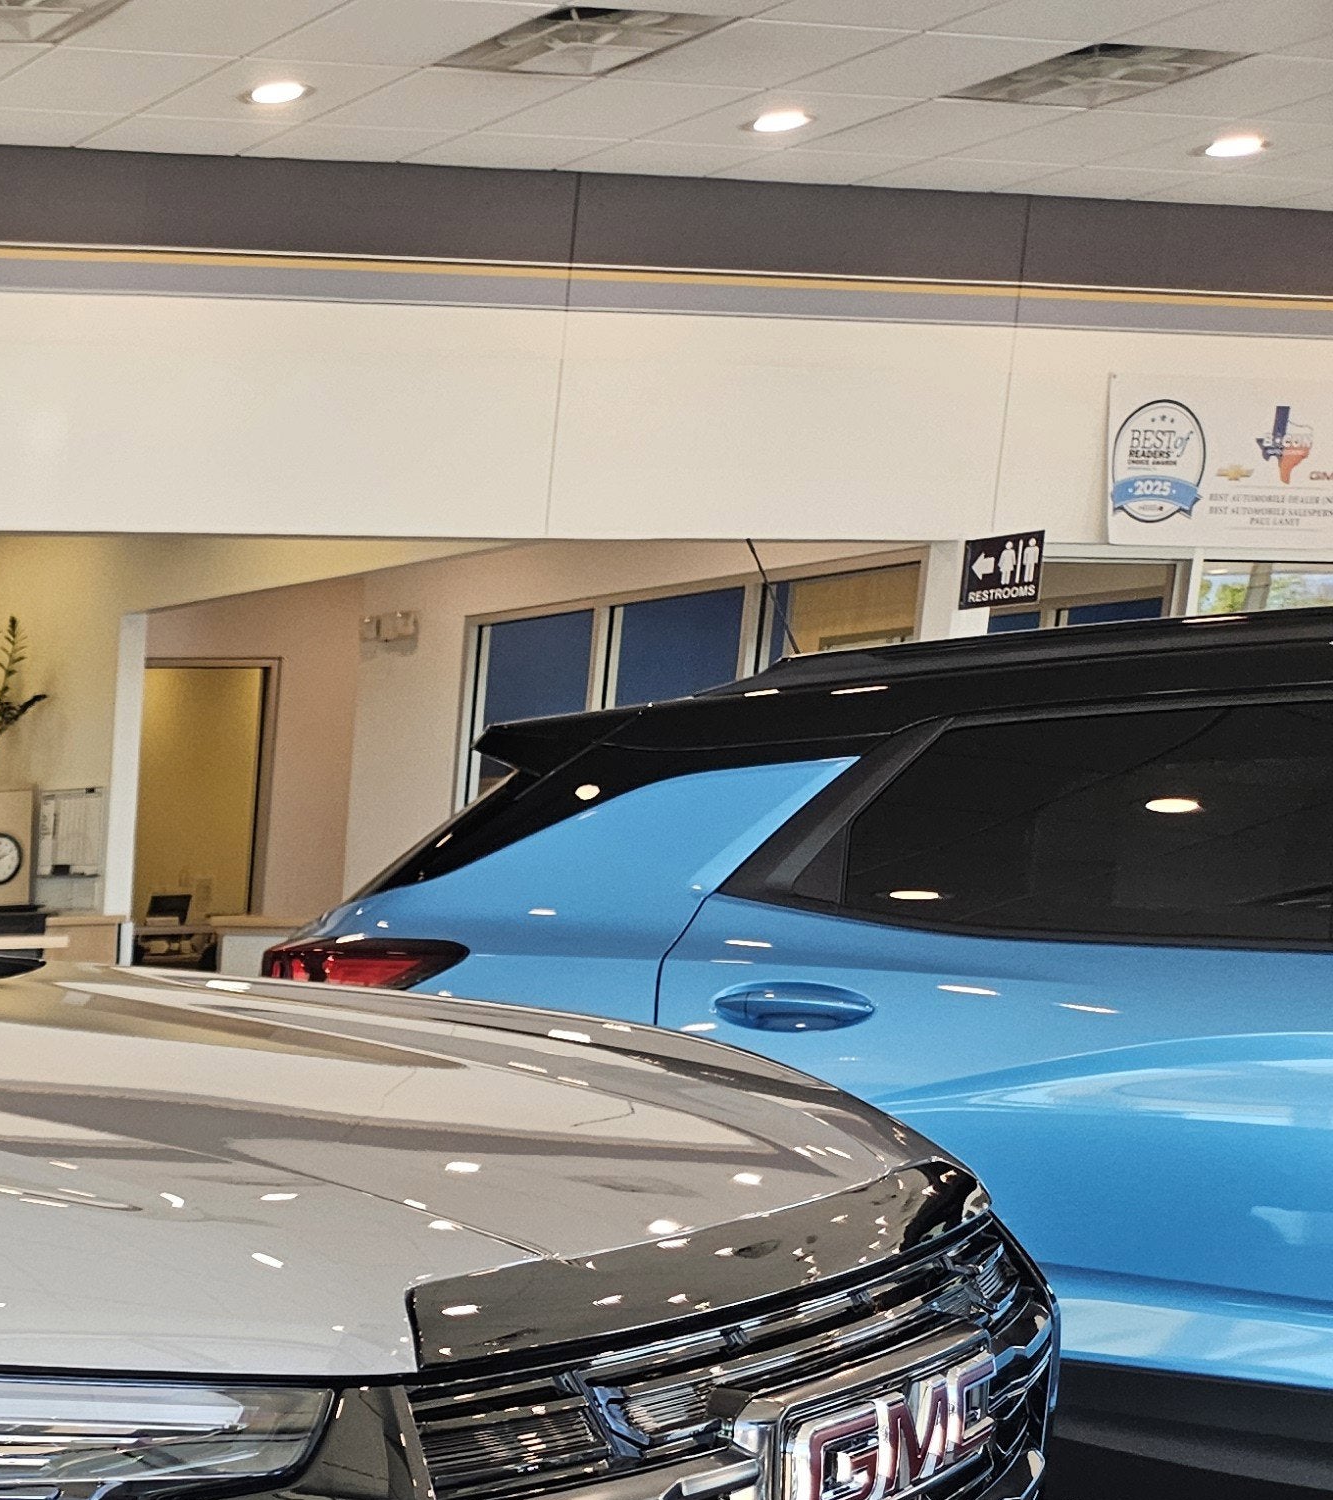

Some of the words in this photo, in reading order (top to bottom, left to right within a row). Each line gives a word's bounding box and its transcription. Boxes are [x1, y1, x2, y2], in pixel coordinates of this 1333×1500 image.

[1130, 429, 1176, 449] BEST
[1173, 430, 1194, 458] of
[1133, 480, 1171, 496] 2025
[968, 584, 1035, 602] RESTROOMS
